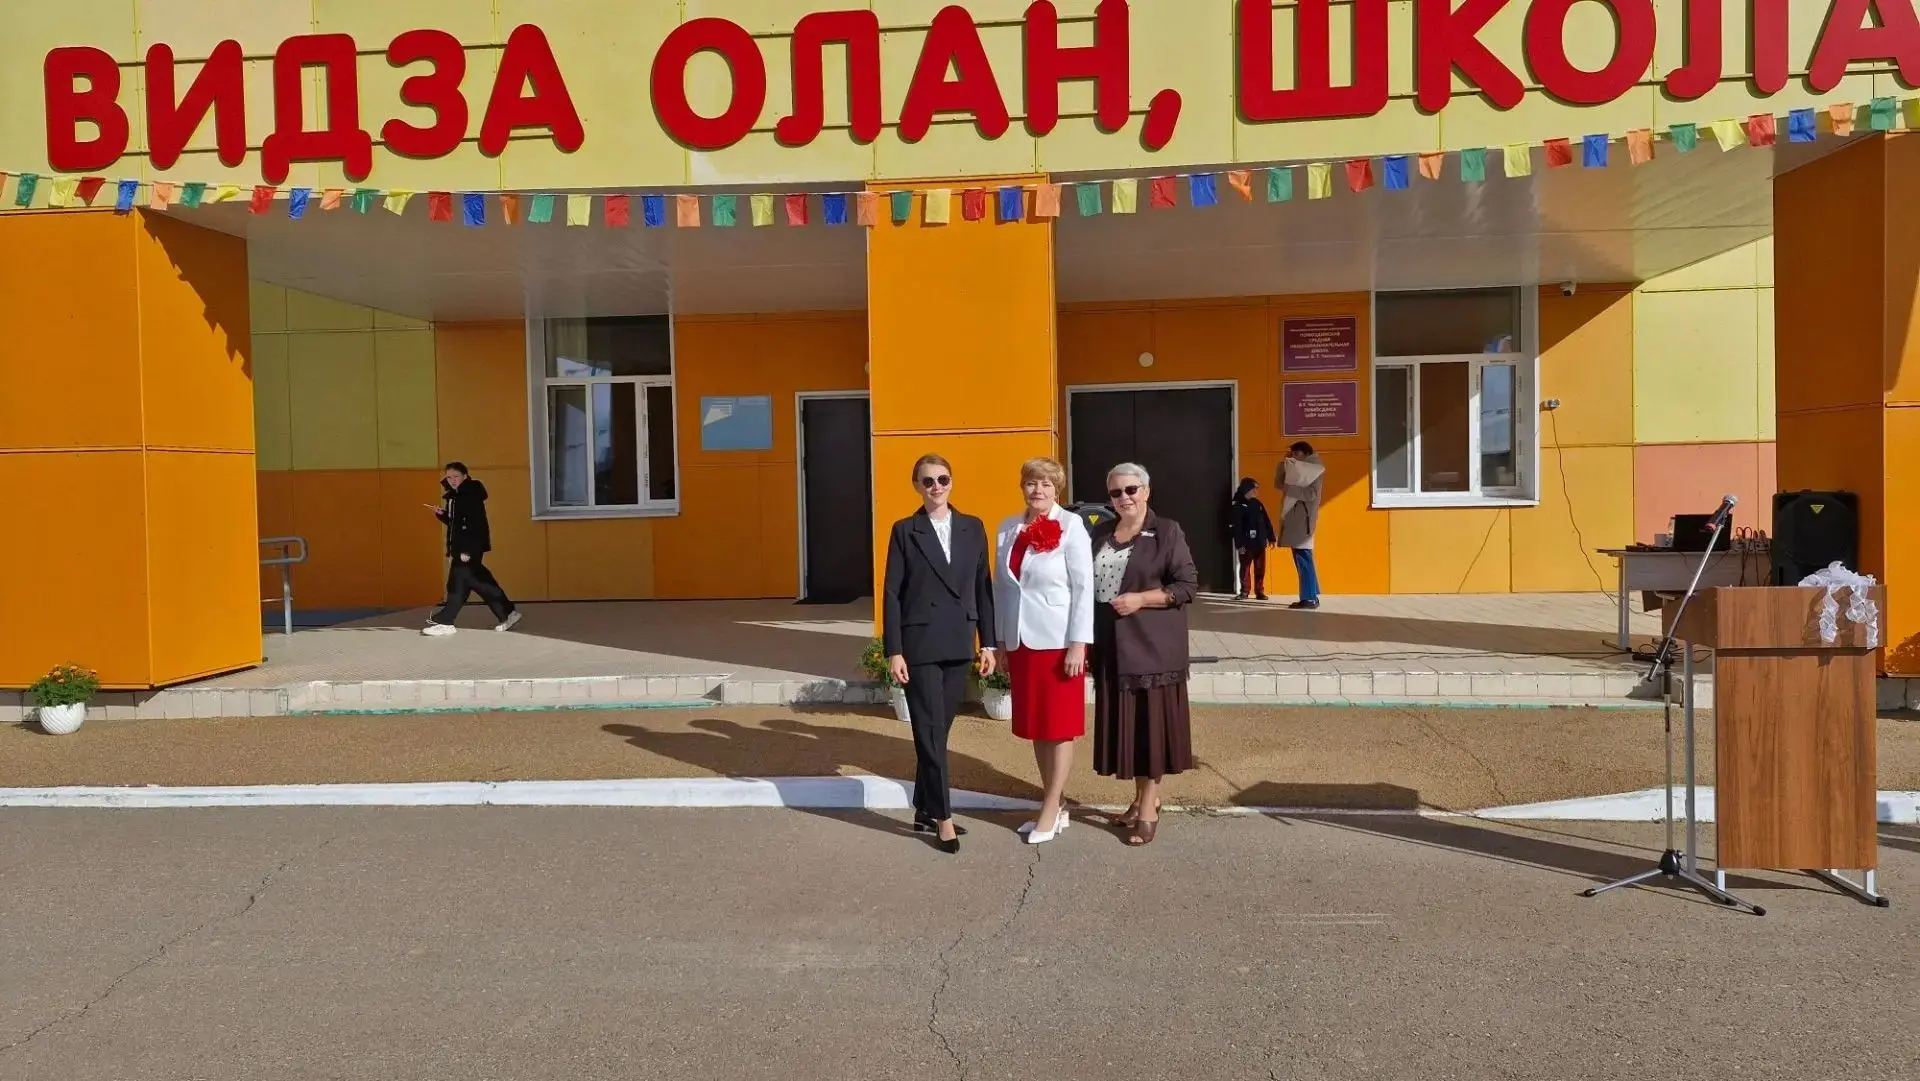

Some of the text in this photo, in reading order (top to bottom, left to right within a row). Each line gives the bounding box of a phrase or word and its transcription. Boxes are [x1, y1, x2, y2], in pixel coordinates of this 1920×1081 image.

[44, 0, 1920, 185] ВИДЗА ОЛАН, ШКОЛА
